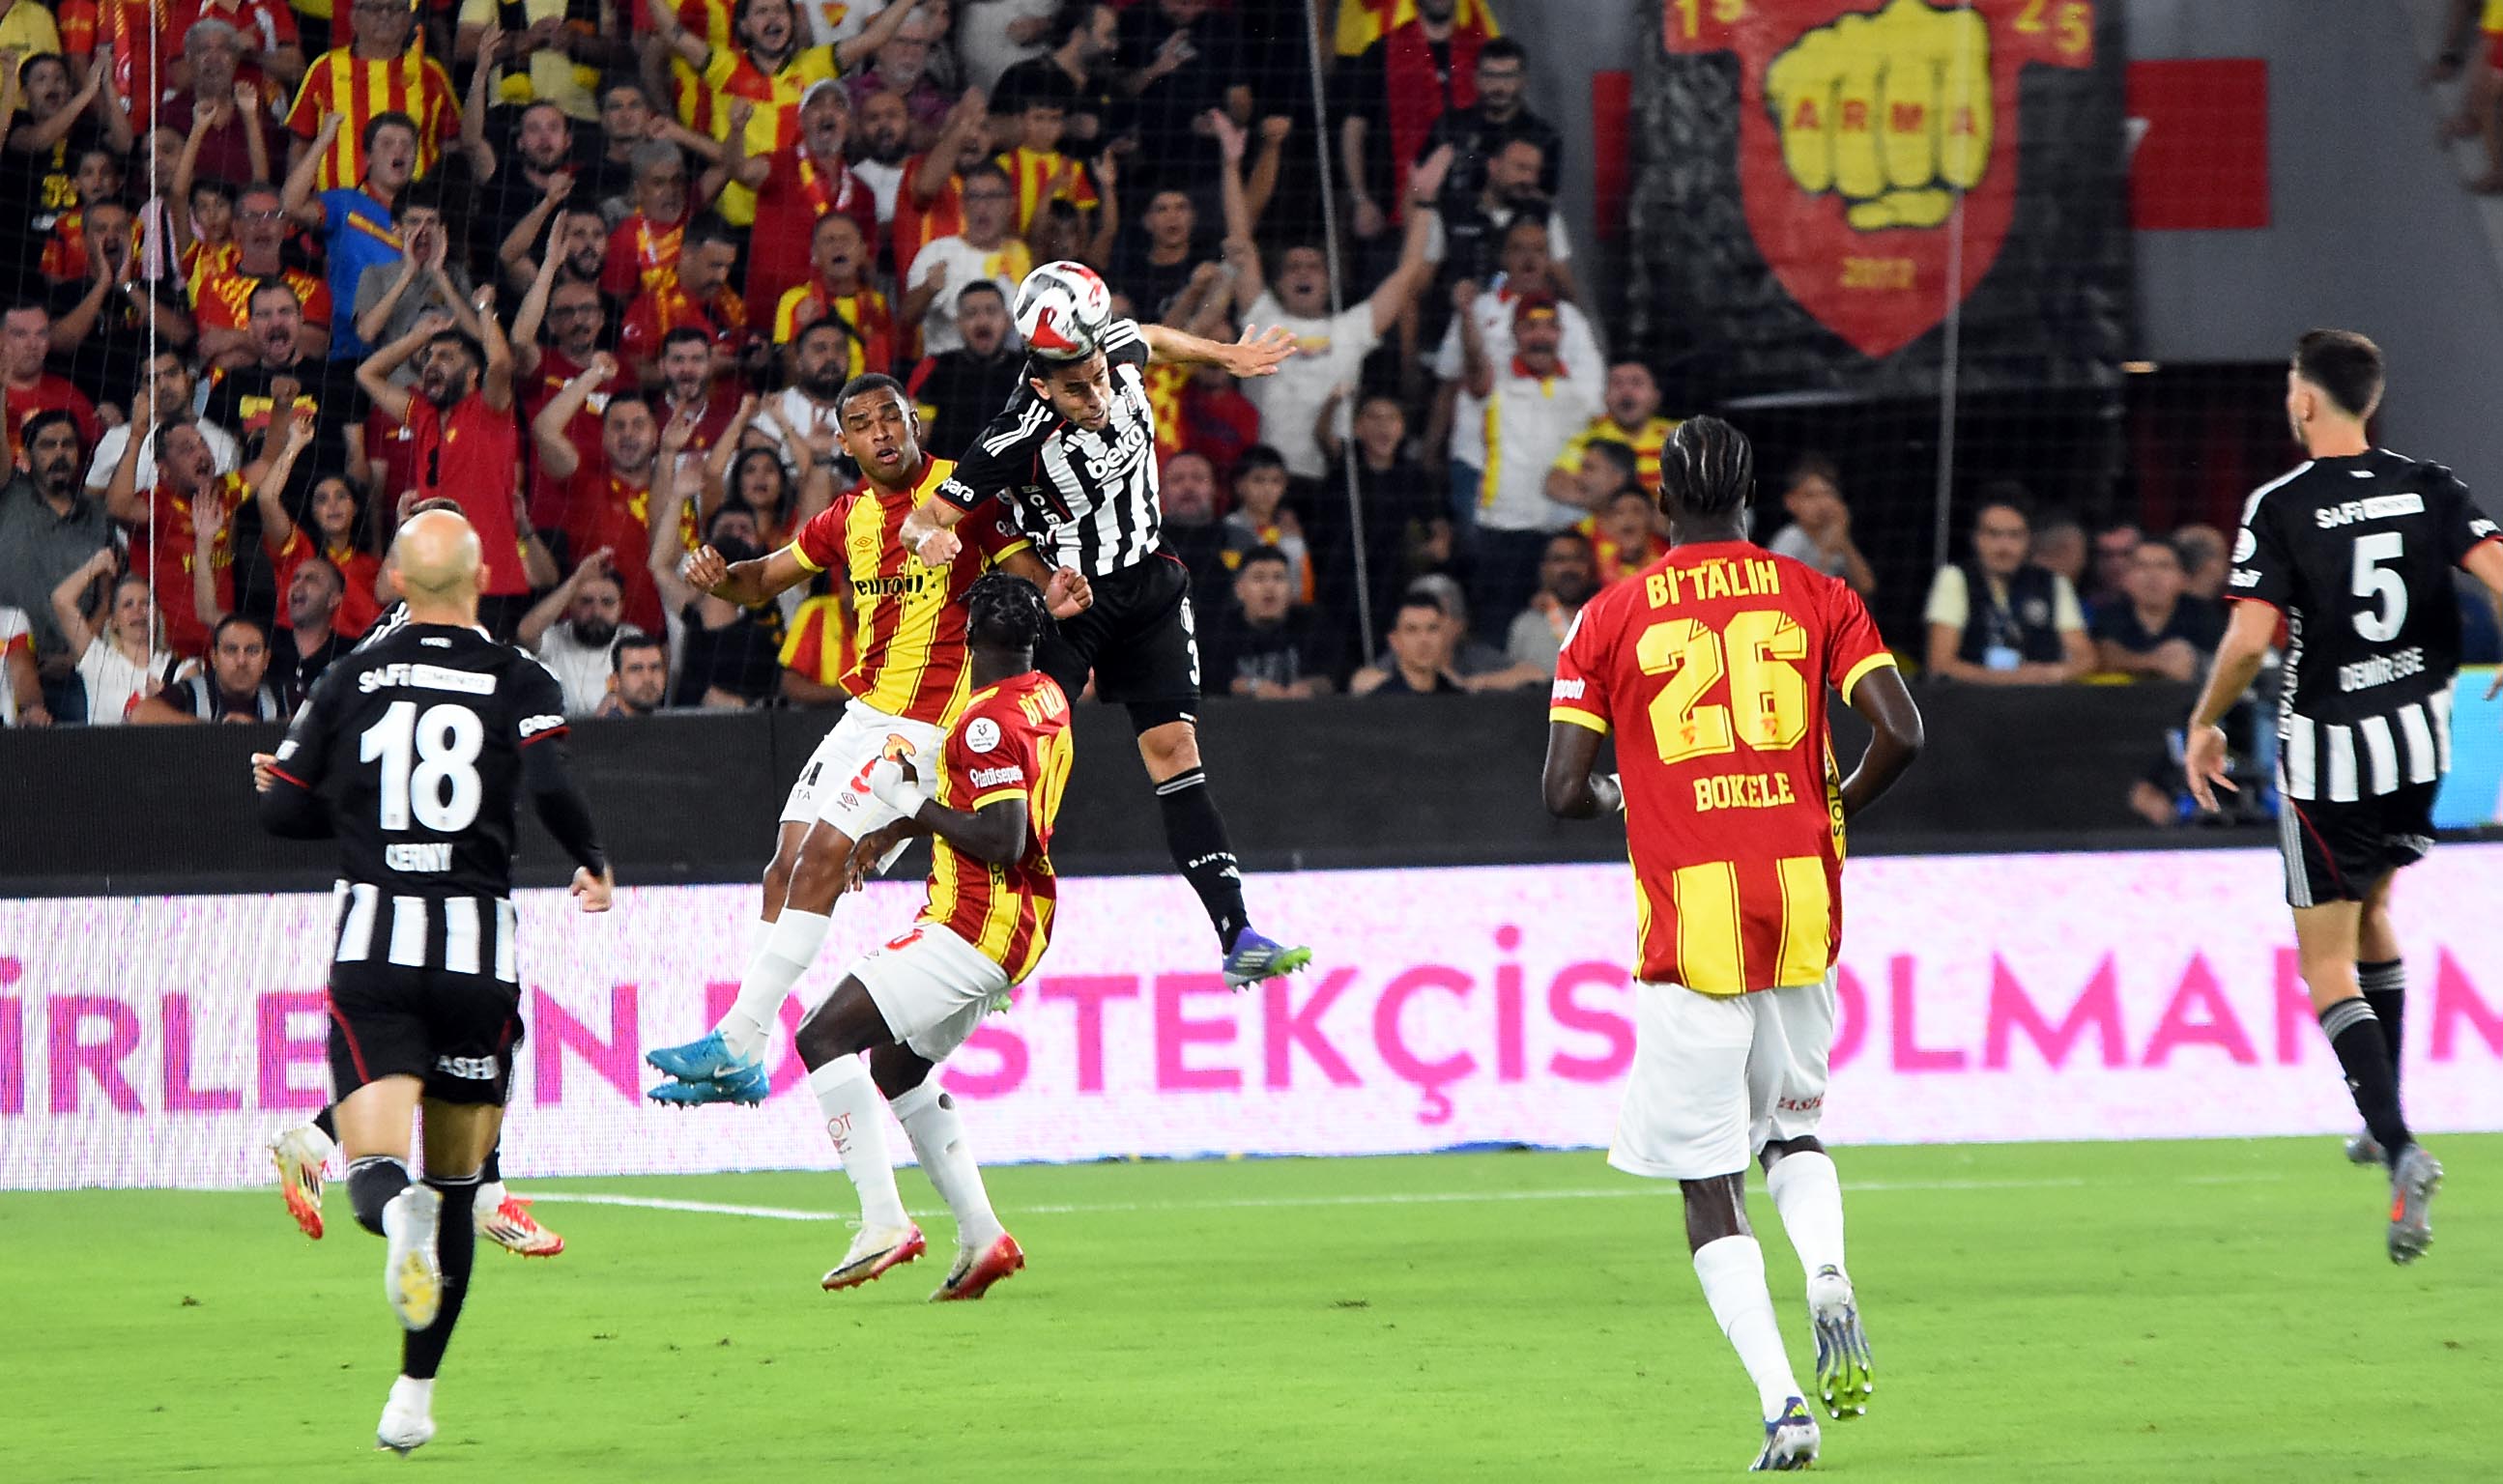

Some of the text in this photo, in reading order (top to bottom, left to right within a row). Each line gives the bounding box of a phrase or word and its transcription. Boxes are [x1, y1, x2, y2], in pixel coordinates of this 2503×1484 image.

[1791, 98, 1978, 136] ARMA
[1084, 424, 1146, 480] beko
[2351, 531, 2408, 642] 5
[1187, 639, 1200, 686] 3
[1635, 610, 1809, 765] 26
[360, 700, 484, 832] 18
[1692, 772, 1796, 813] BOKELE
